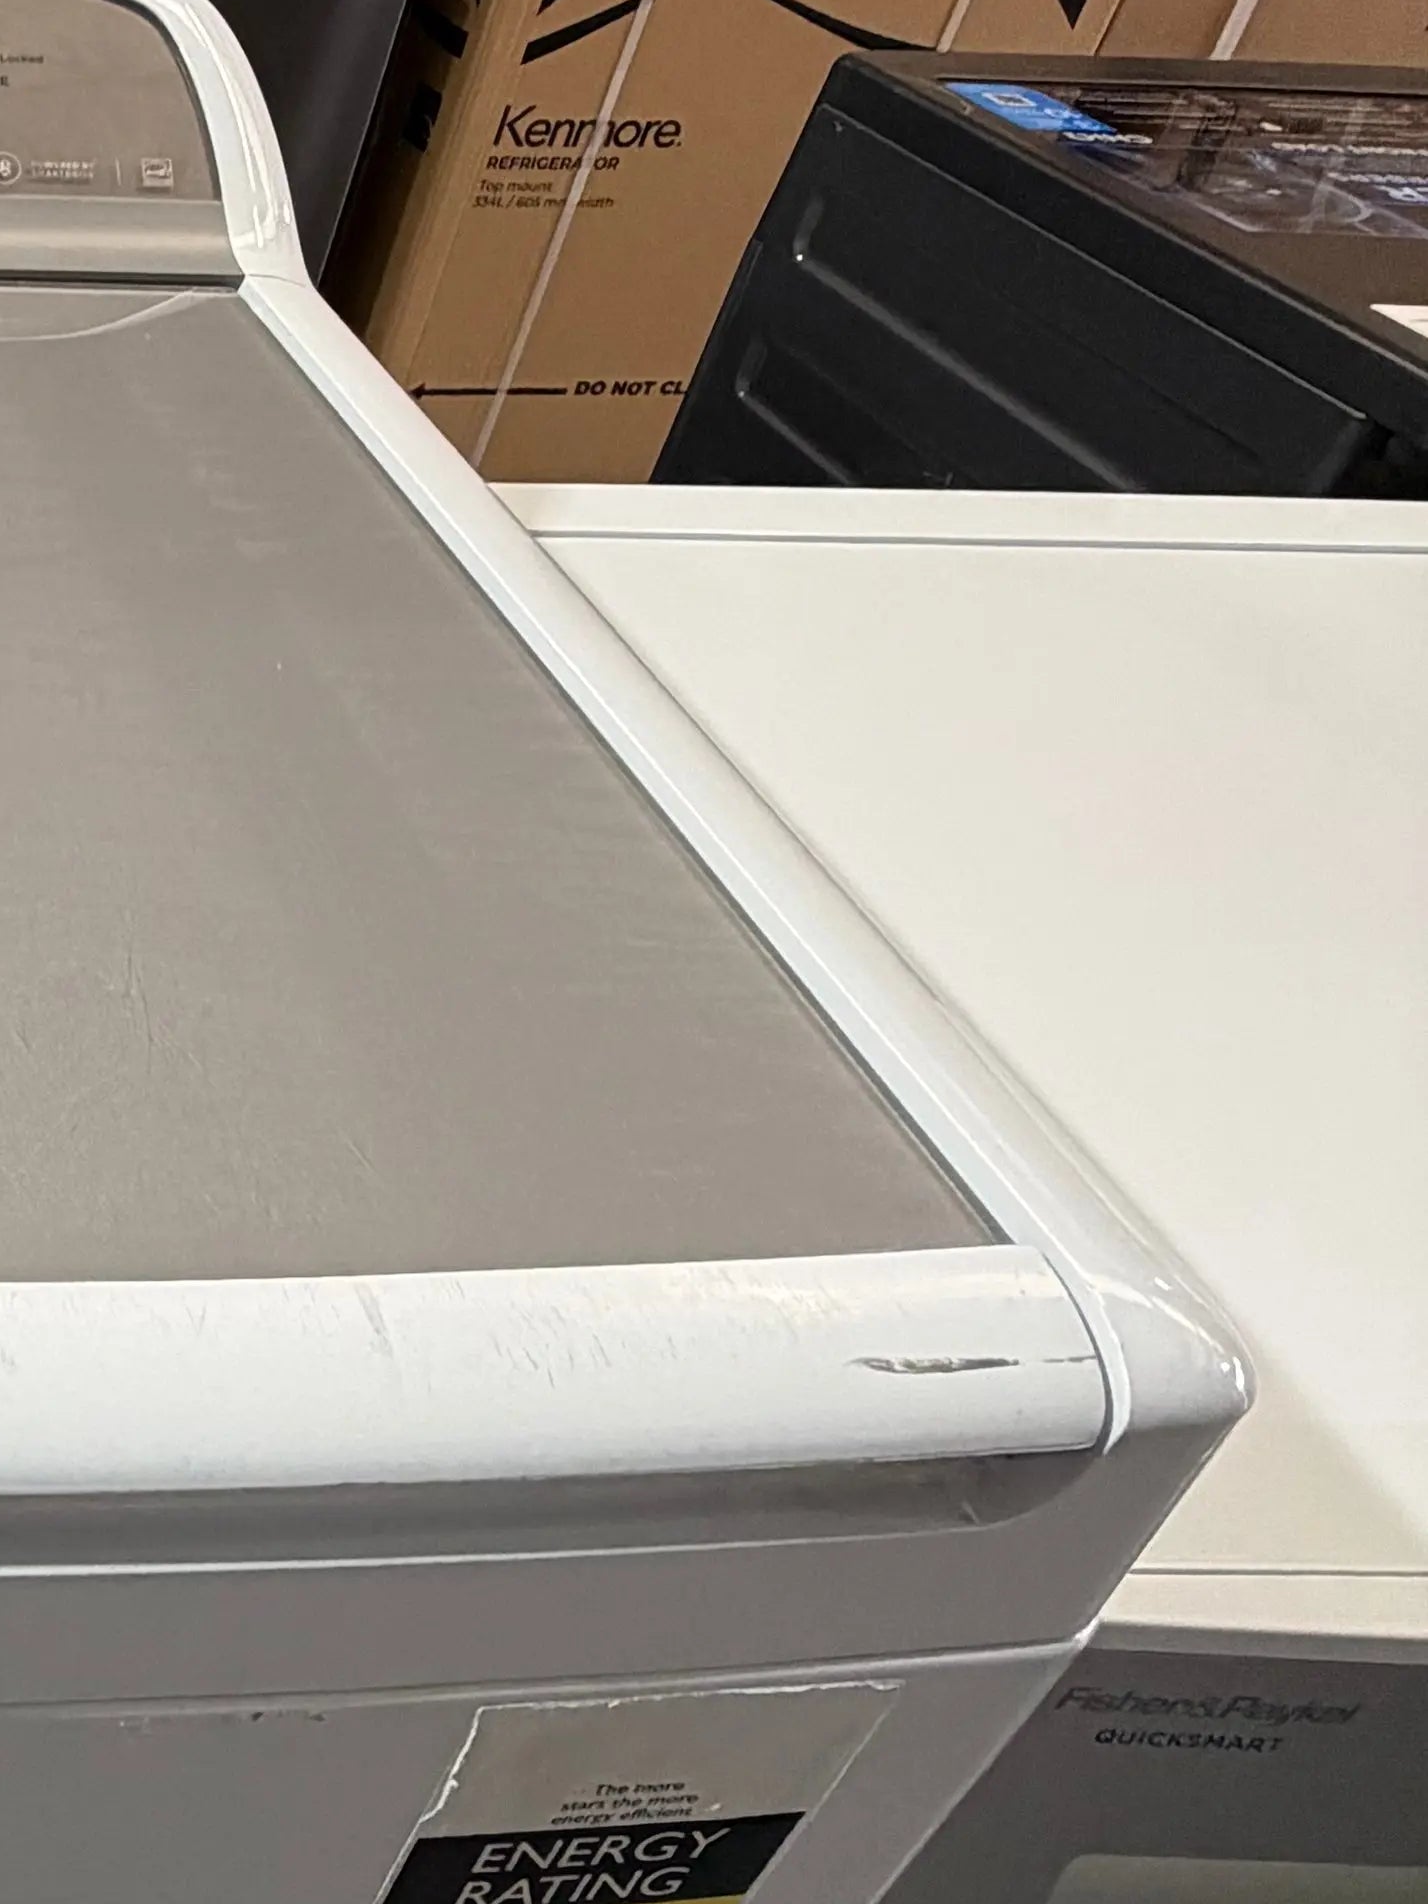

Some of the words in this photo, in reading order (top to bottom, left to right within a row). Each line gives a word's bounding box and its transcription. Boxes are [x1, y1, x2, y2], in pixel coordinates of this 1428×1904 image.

[0, 54, 44, 65] Locked
[486, 155, 620, 172] REFRIGERAOR
[480, 178, 504, 194] Top
[506, 180, 553, 192] mount
[574, 381, 606, 396] DO
[610, 381, 657, 396] NOT
[1094, 1728, 1285, 1753] QUICKSMART
[596, 1783, 630, 1796] The
[634, 1781, 686, 1793] more
[560, 1798, 608, 1812] stars
[612, 1796, 644, 1809] the
[647, 1794, 699, 1806] more
[550, 1811, 614, 1827] energy
[619, 1806, 694, 1822] efficient
[471, 1827, 732, 1874] ENERGY
